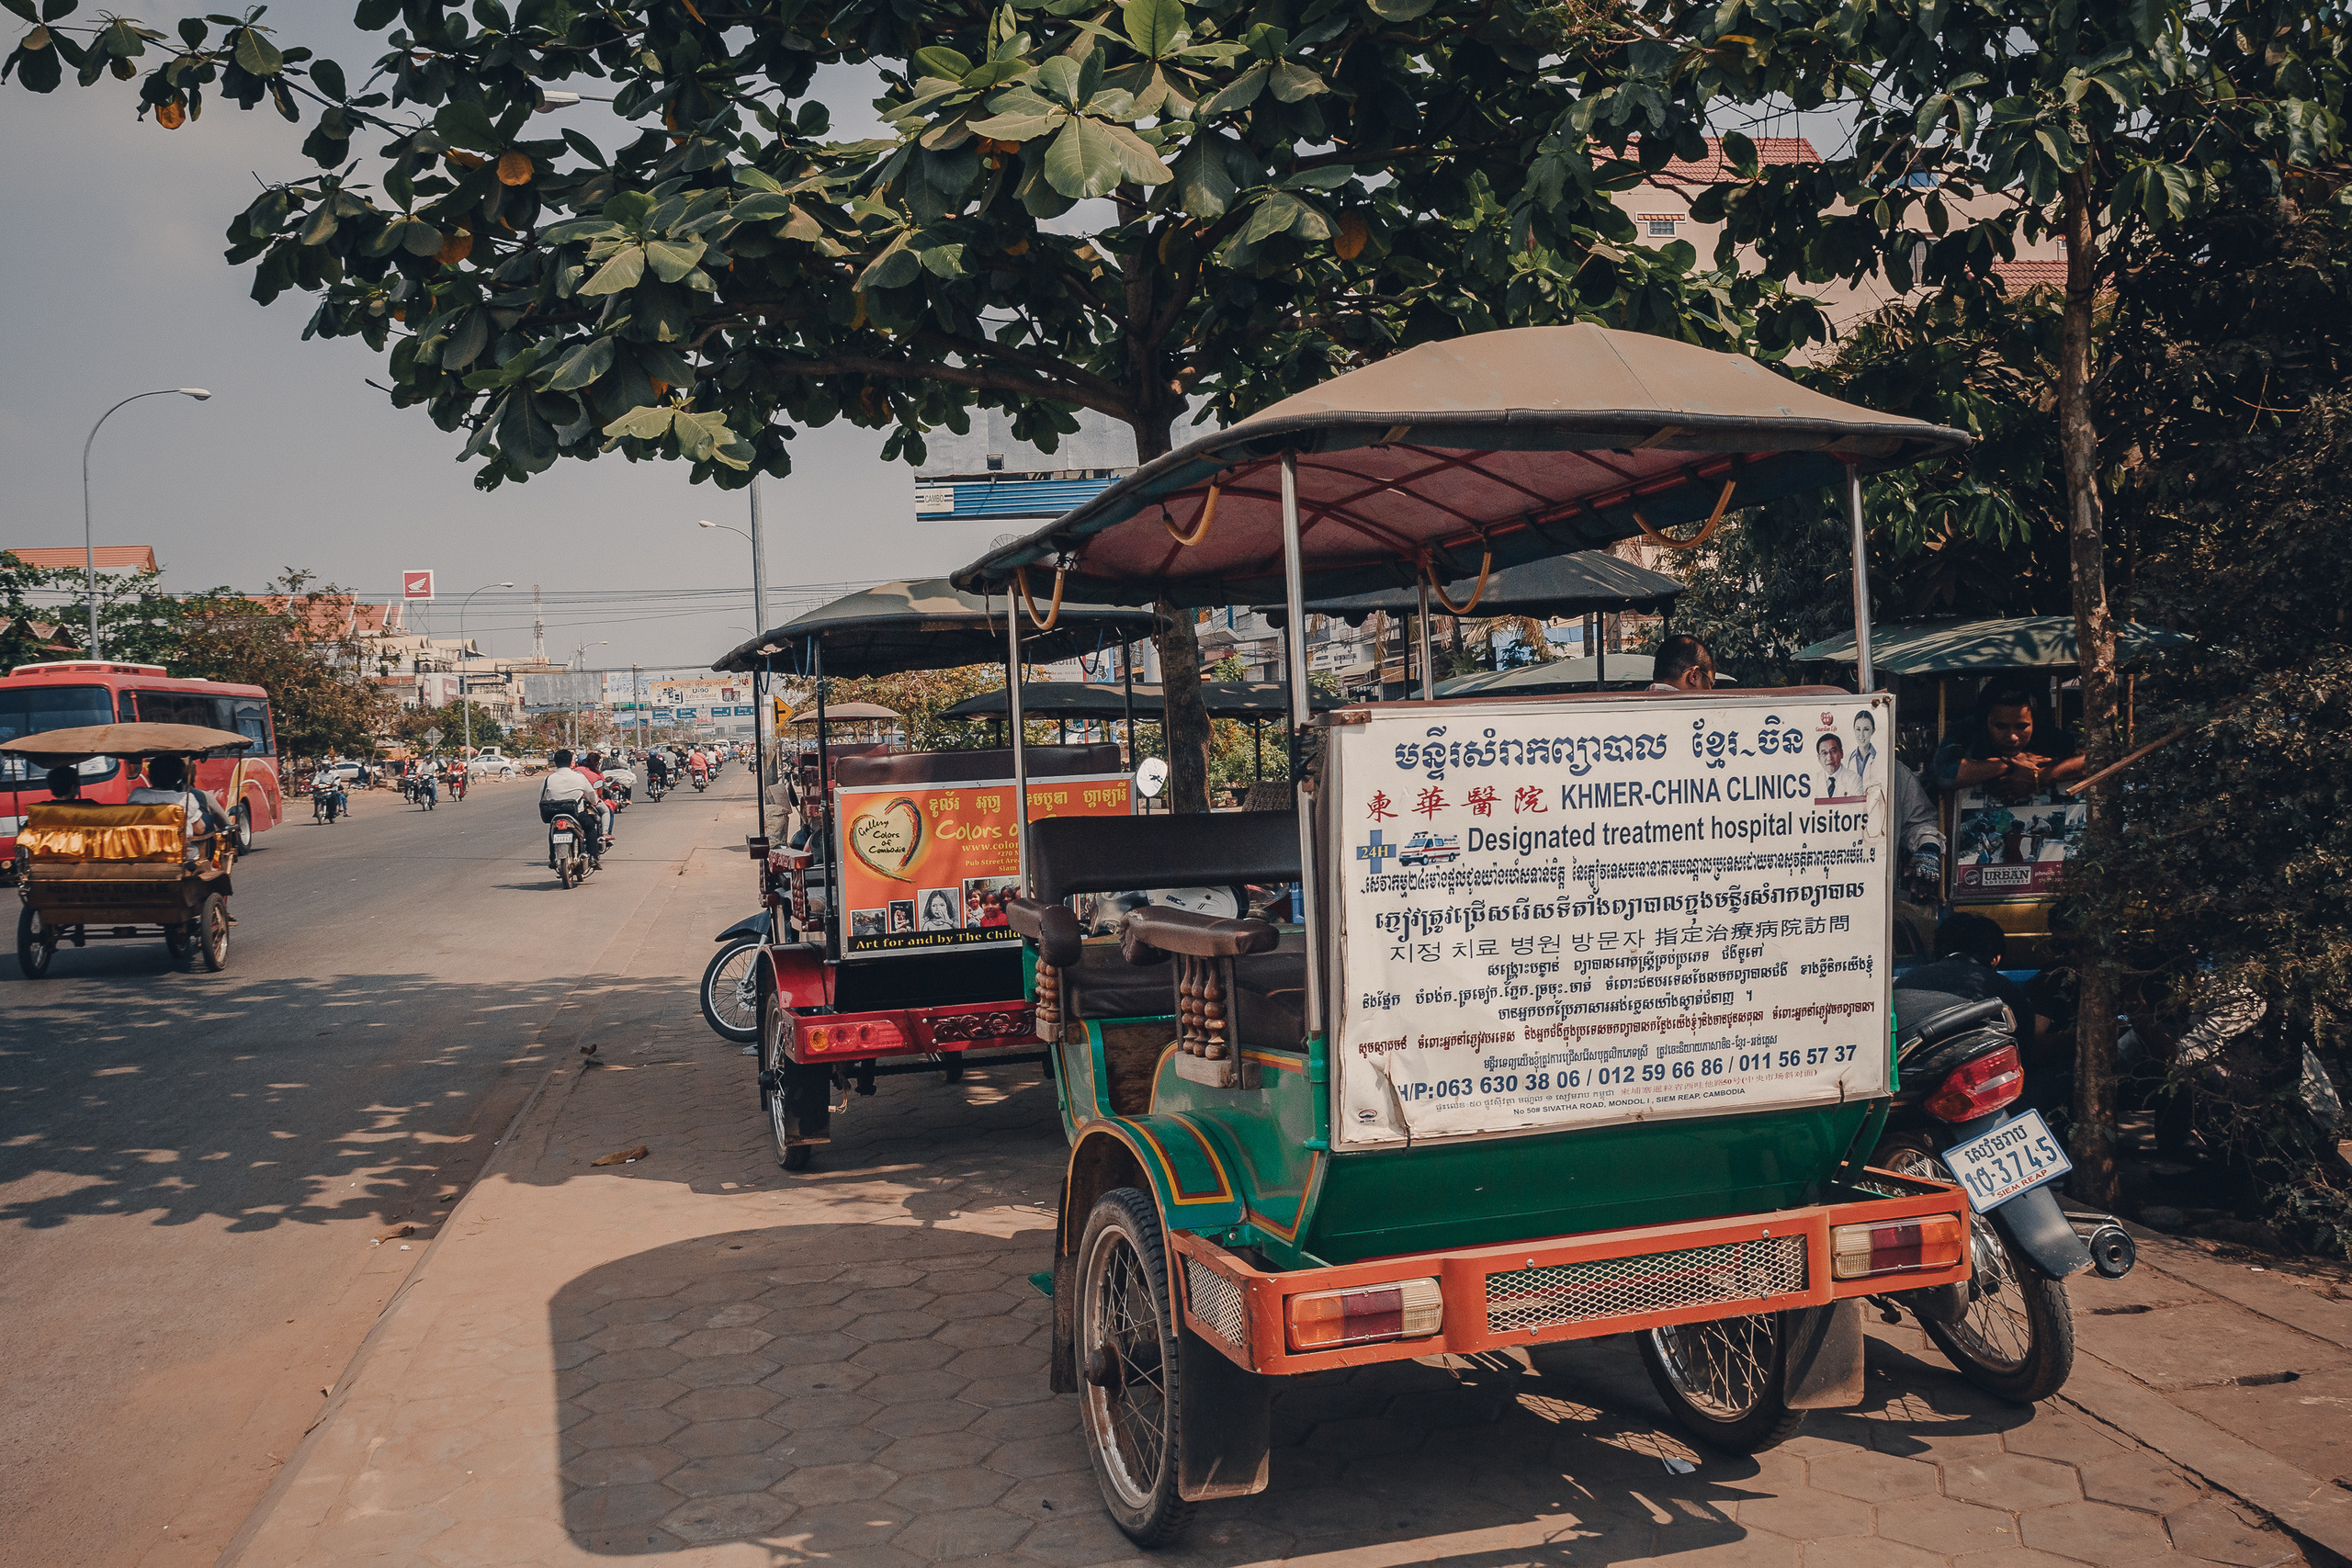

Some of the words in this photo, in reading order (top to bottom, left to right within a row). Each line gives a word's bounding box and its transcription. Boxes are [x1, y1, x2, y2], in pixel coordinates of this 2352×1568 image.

[1562, 777, 1721, 810] KHMER-CHINA
[1726, 773, 1812, 802] CLINICS
[858, 818, 889, 836] Gallery
[873, 830, 900, 840] Colors
[935, 819, 1003, 841] Colors
[1467, 821, 1596, 856] Designated
[1603, 818, 1704, 846] treatment
[1711, 810, 1792, 843] hospital
[1361, 845, 1389, 859] 24H
[1984, 870, 2030, 881] URBAN
[855, 940, 879, 950] Art
[884, 938, 904, 948] for
[908, 934, 933, 946] and
[937, 933, 954, 945] by
[956, 931, 982, 942] The
[1655, 914, 1850, 947] 指定治療病院訪問
[1389, 941, 1442, 964] 지정
[1453, 938, 1500, 959] 치료
[1511, 933, 1561, 956] 병원
[1572, 928, 1645, 953] 방문자
[1479, 1074, 1519, 1094] 630
[1524, 1072, 1551, 1091] 38
[1556, 1069, 1581, 1089] 06
[1586, 1068, 1593, 1087] /
[1598, 1066, 1635, 1086] 012
[1642, 1063, 1667, 1081] 59
[1672, 1060, 1695, 1079] 66
[1701, 1057, 1724, 1077] 86
[1727, 1055, 1735, 1074] /
[1739, 1052, 1771, 1072] 011
[1778, 1049, 1801, 1067] 56
[1806, 1046, 1829, 1066] 57
[1834, 1043, 1858, 1063] 37
[1543, 1104, 1578, 1112] SIVATHA
[1579, 1101, 1607, 1110] ROAD,
[1609, 1098, 1646, 1107] MONDOL
[1656, 1095, 1676, 1103] SIEM
[1702, 1088, 1746, 1099] CAMBODIA
[1964, 1124, 2028, 1164] សៀមរាប
[1997, 1183, 2021, 1198] SIEM
[2021, 1169, 2047, 1187] REAP
